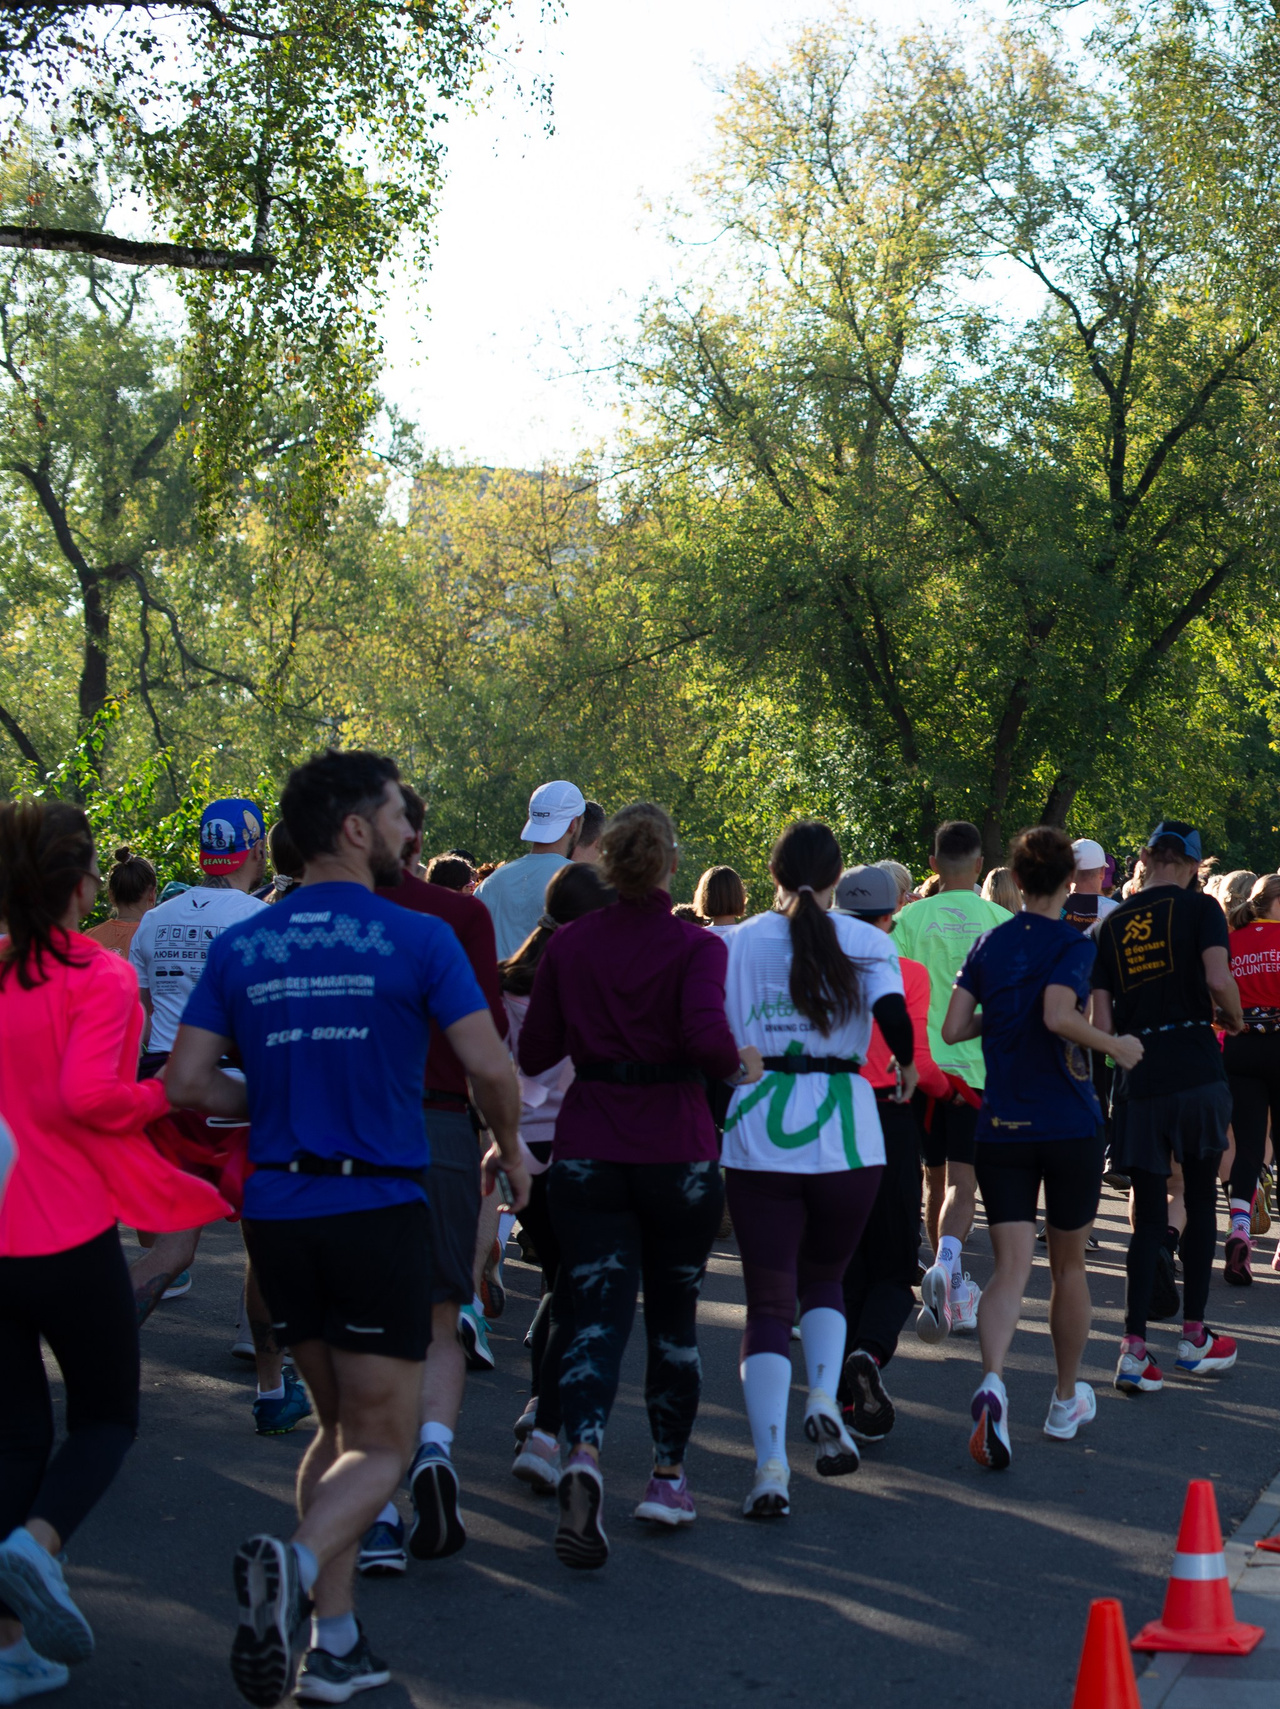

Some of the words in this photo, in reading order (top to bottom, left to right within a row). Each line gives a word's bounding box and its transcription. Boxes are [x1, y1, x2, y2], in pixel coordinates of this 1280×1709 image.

[203, 858, 231, 866] BEAVIS
[154, 951, 179, 959] ЛЮБИ
[310, 974, 375, 988] MARATHON
